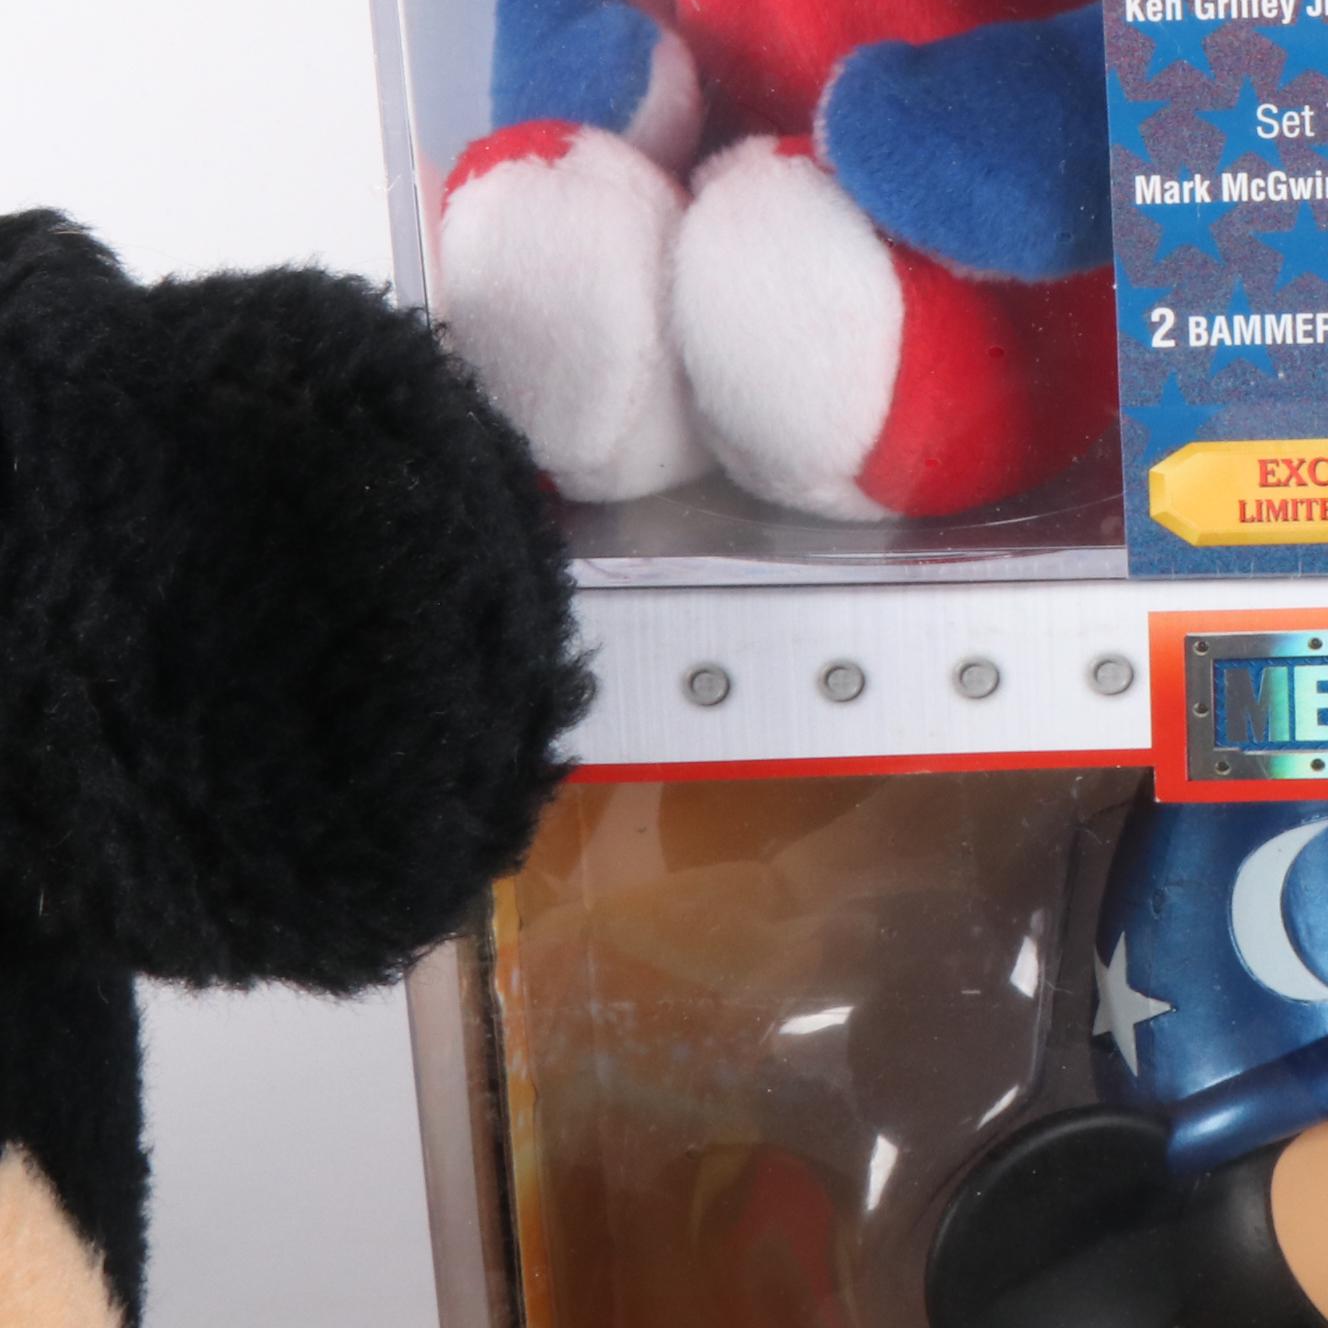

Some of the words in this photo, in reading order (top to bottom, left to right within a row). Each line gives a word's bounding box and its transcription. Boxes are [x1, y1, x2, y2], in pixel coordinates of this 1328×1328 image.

[1256, 103, 1315, 140] Set
[1134, 173, 1212, 206] Mark
[1150, 307, 1177, 349] 2
